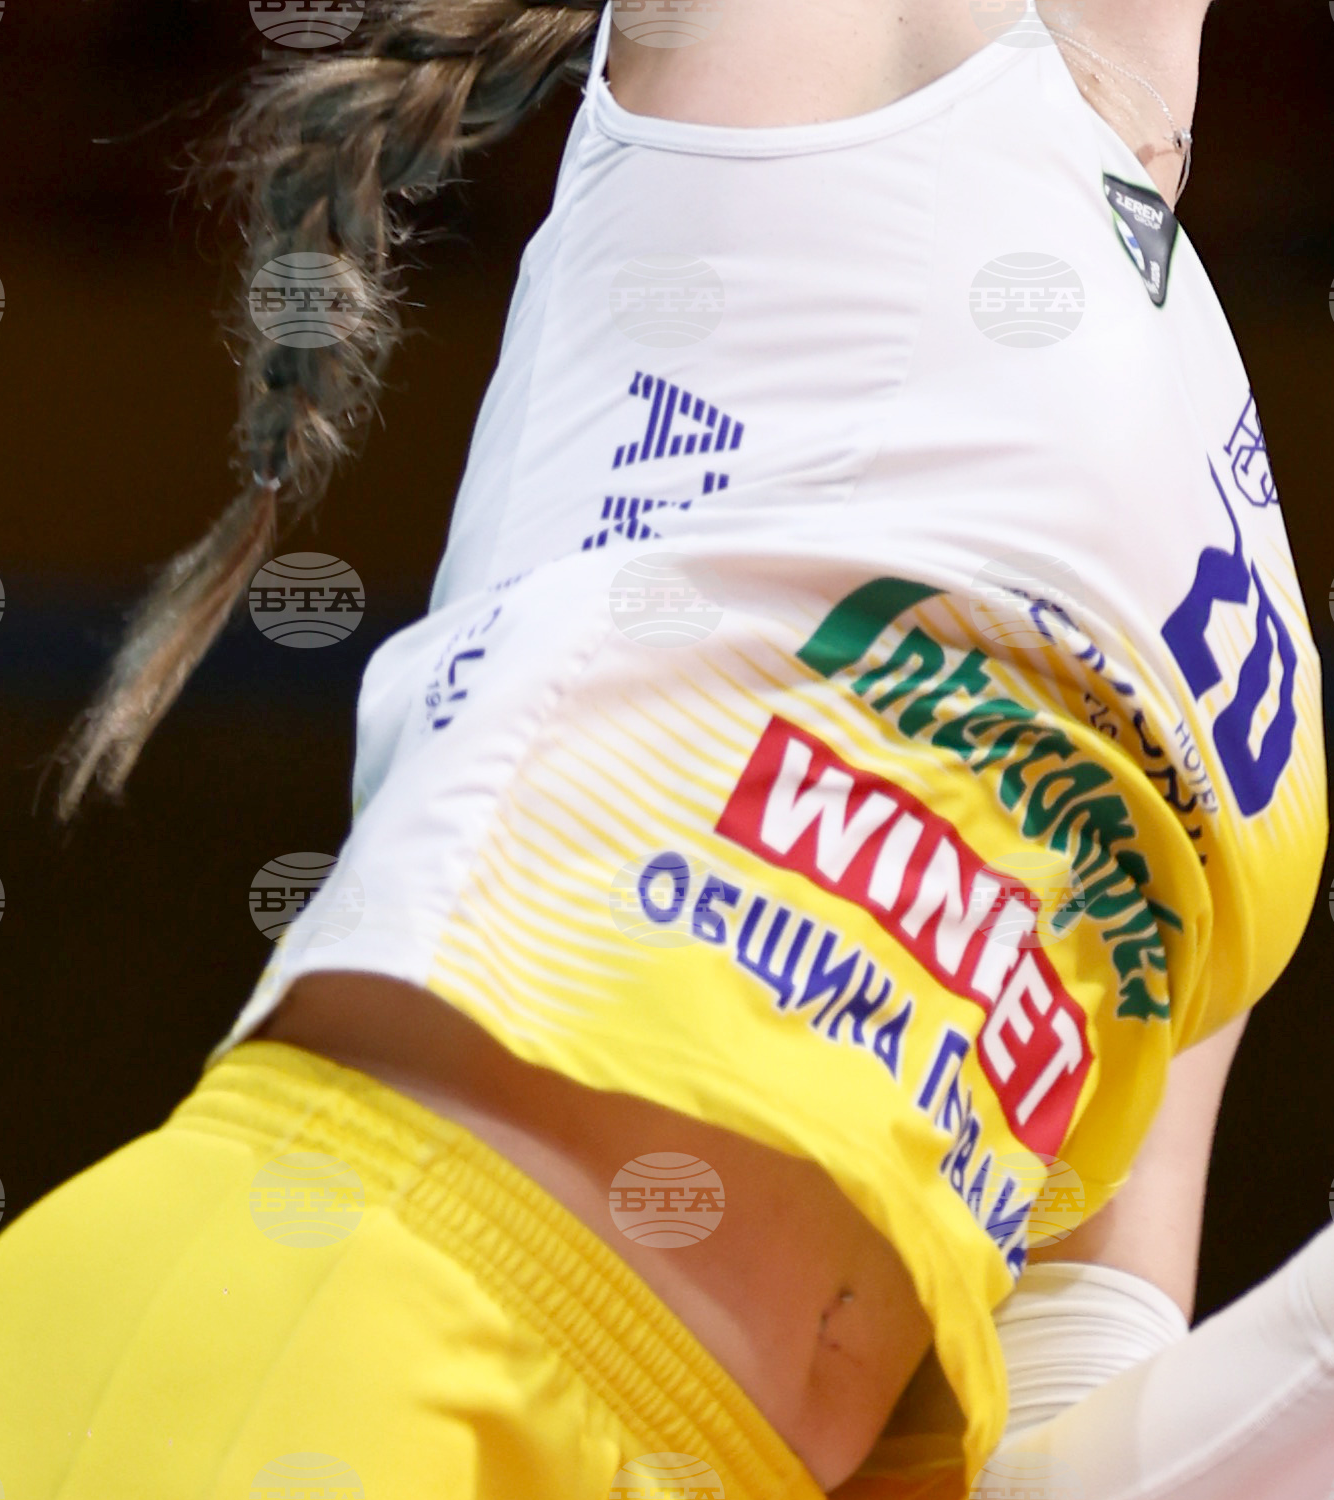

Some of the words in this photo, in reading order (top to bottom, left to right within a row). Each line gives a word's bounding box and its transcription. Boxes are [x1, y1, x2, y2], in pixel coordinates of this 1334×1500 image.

[1116, 191, 1164, 225] ZEREN
[1159, 454, 1297, 817] 20
[637, 851, 913, 1082] ОБЩИНА
